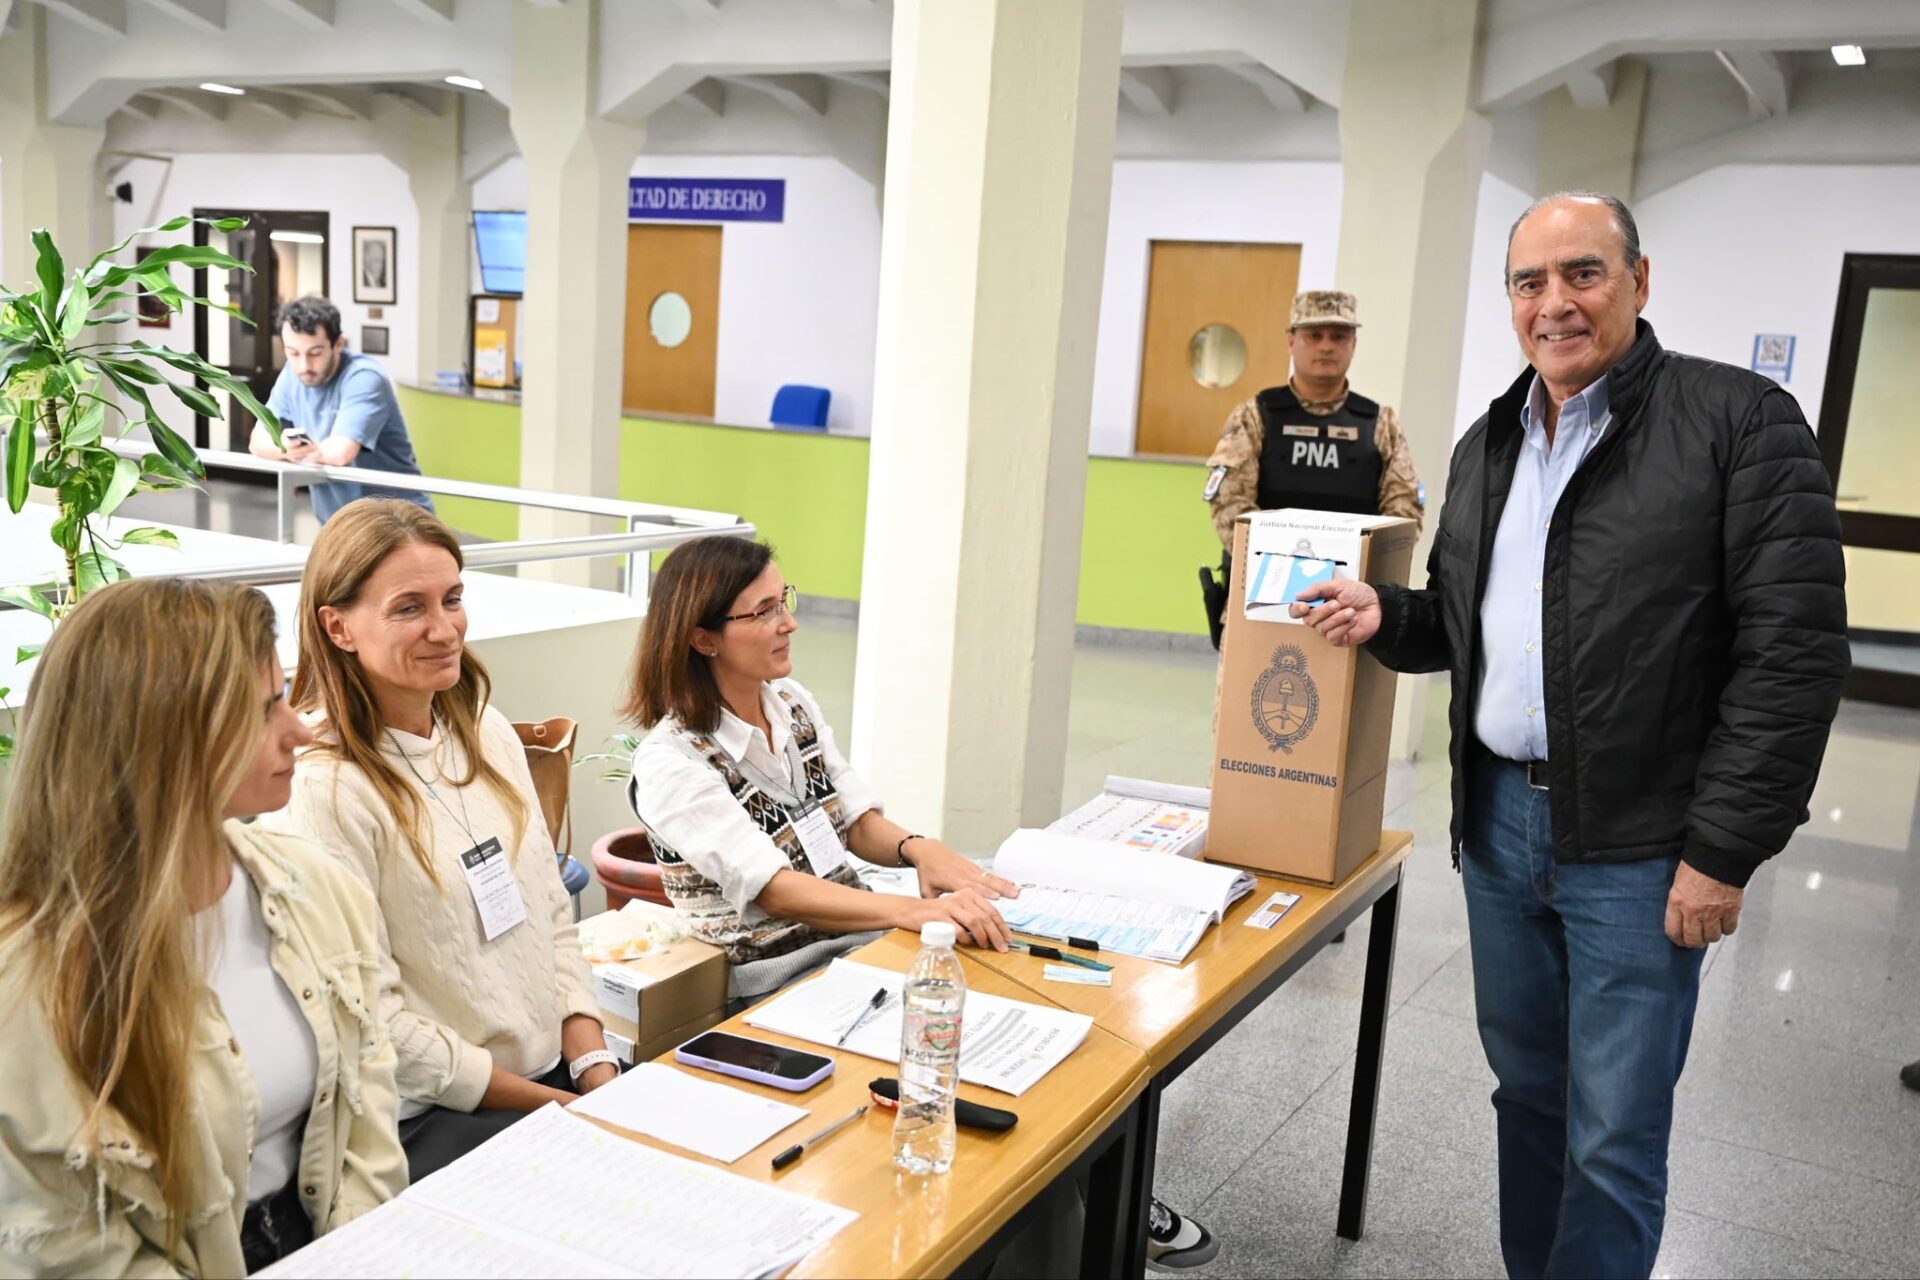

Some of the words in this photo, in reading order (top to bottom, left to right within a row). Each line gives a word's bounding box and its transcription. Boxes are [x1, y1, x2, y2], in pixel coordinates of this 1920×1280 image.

[668, 188, 690, 210] DE
[692, 189, 767, 212] DERECHO
[1291, 441, 1340, 469] PNA
[1258, 521, 1287, 529] Justicia
[1289, 522, 1320, 531] Nacional
[1322, 524, 1355, 533] Electoral
[1220, 758, 1276, 777] ELECCIONES
[1278, 768, 1337, 788] ARGENTINAS
